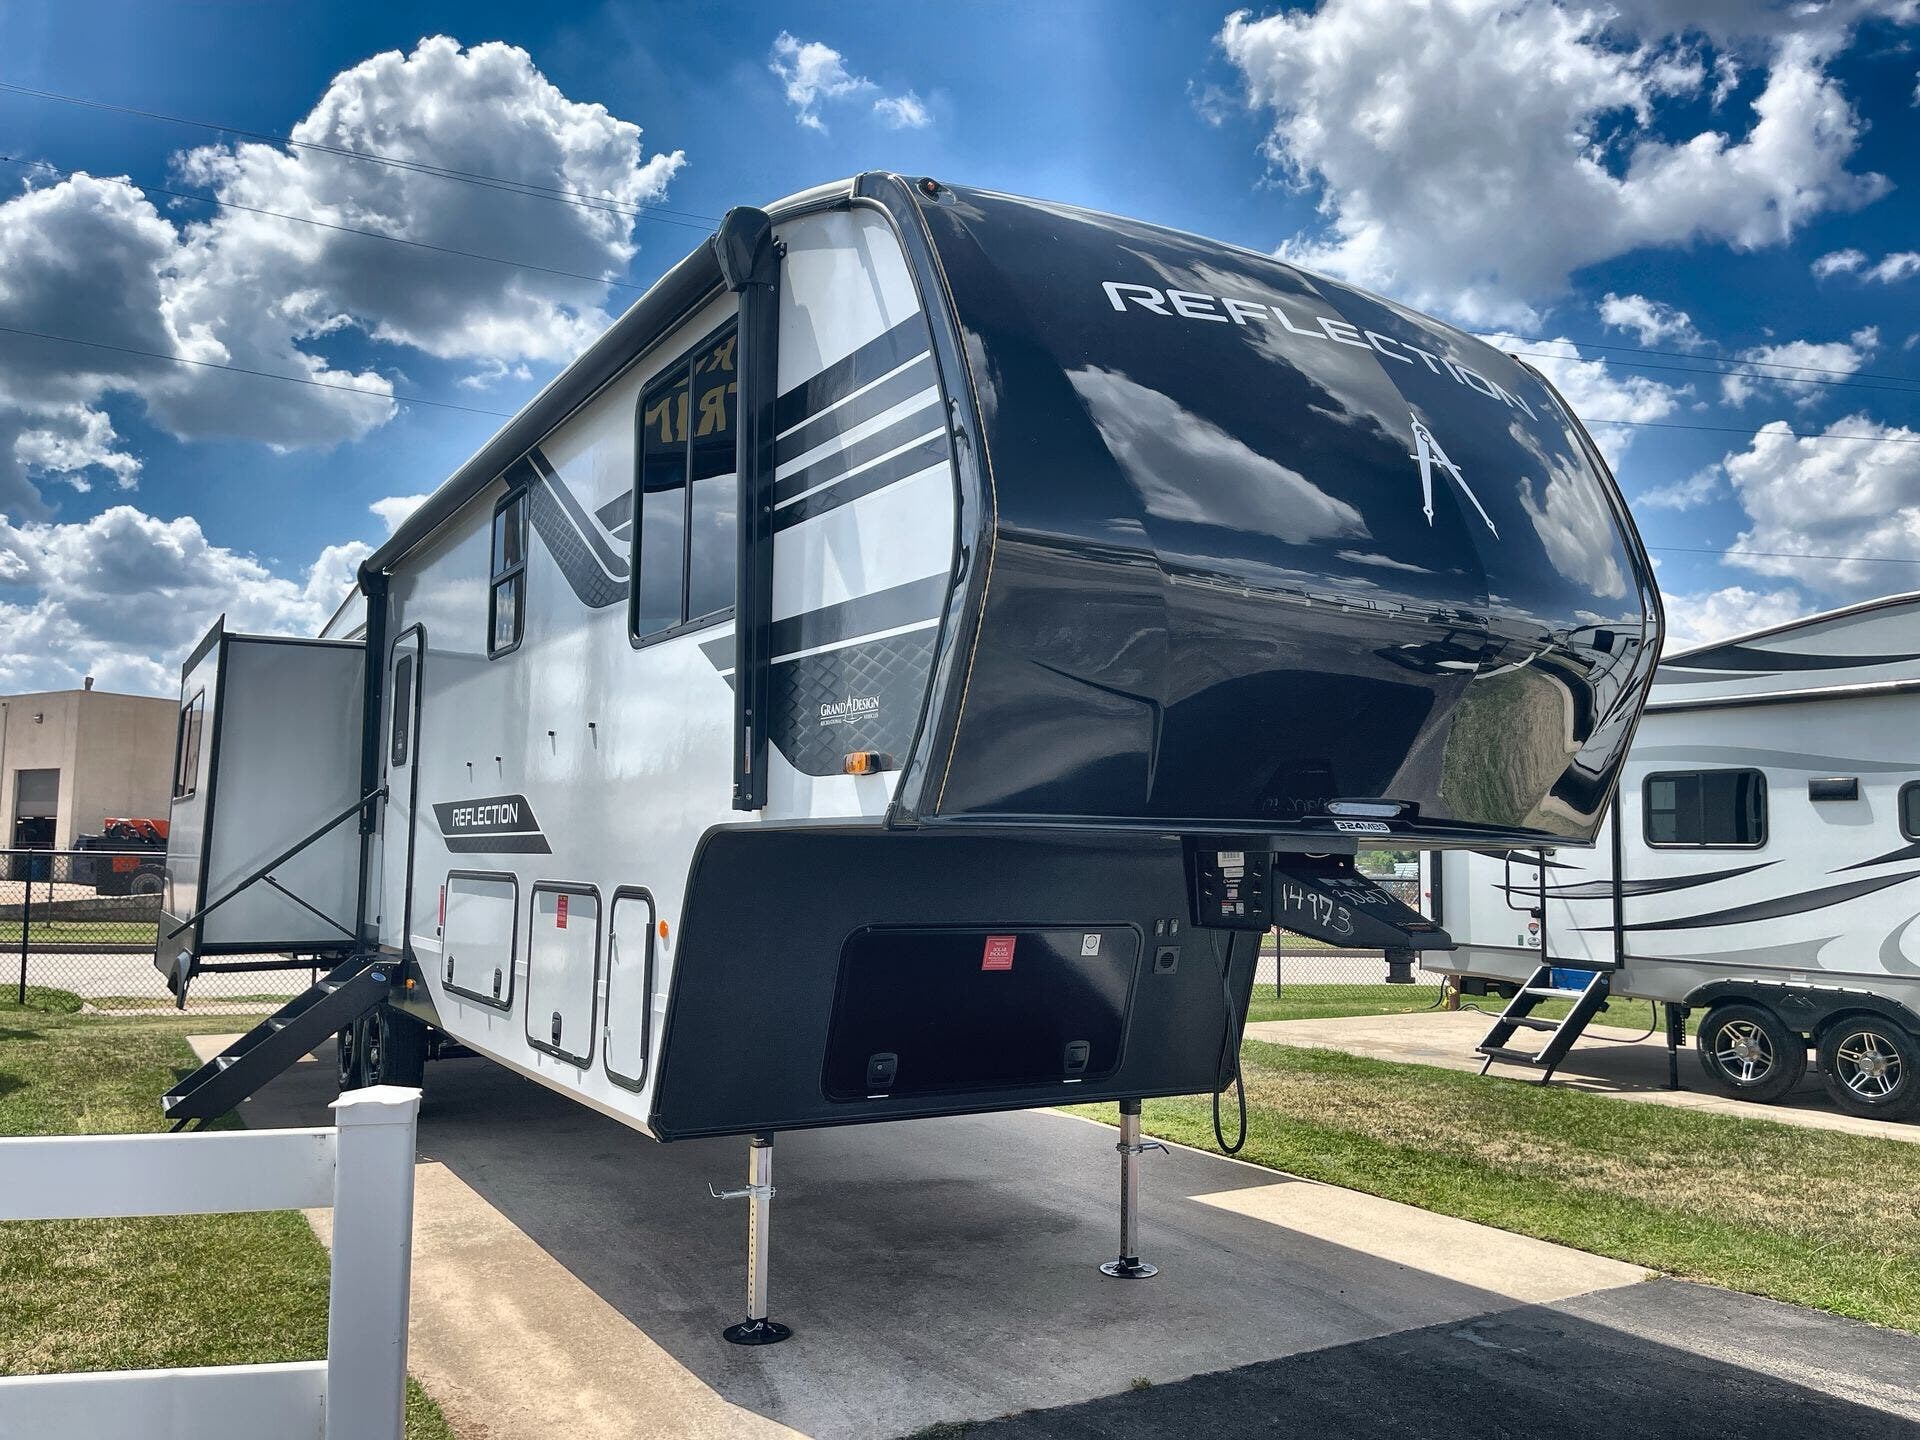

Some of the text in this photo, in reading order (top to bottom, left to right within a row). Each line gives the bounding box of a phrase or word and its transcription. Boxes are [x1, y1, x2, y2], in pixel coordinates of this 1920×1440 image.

[1101, 281, 1538, 421] REFLECTION
[820, 694, 880, 716] GRAND DESIGN
[452, 803, 519, 827] REFLECTION
[1336, 821, 1388, 831] 324MBS
[1283, 883, 1354, 936] 14973
